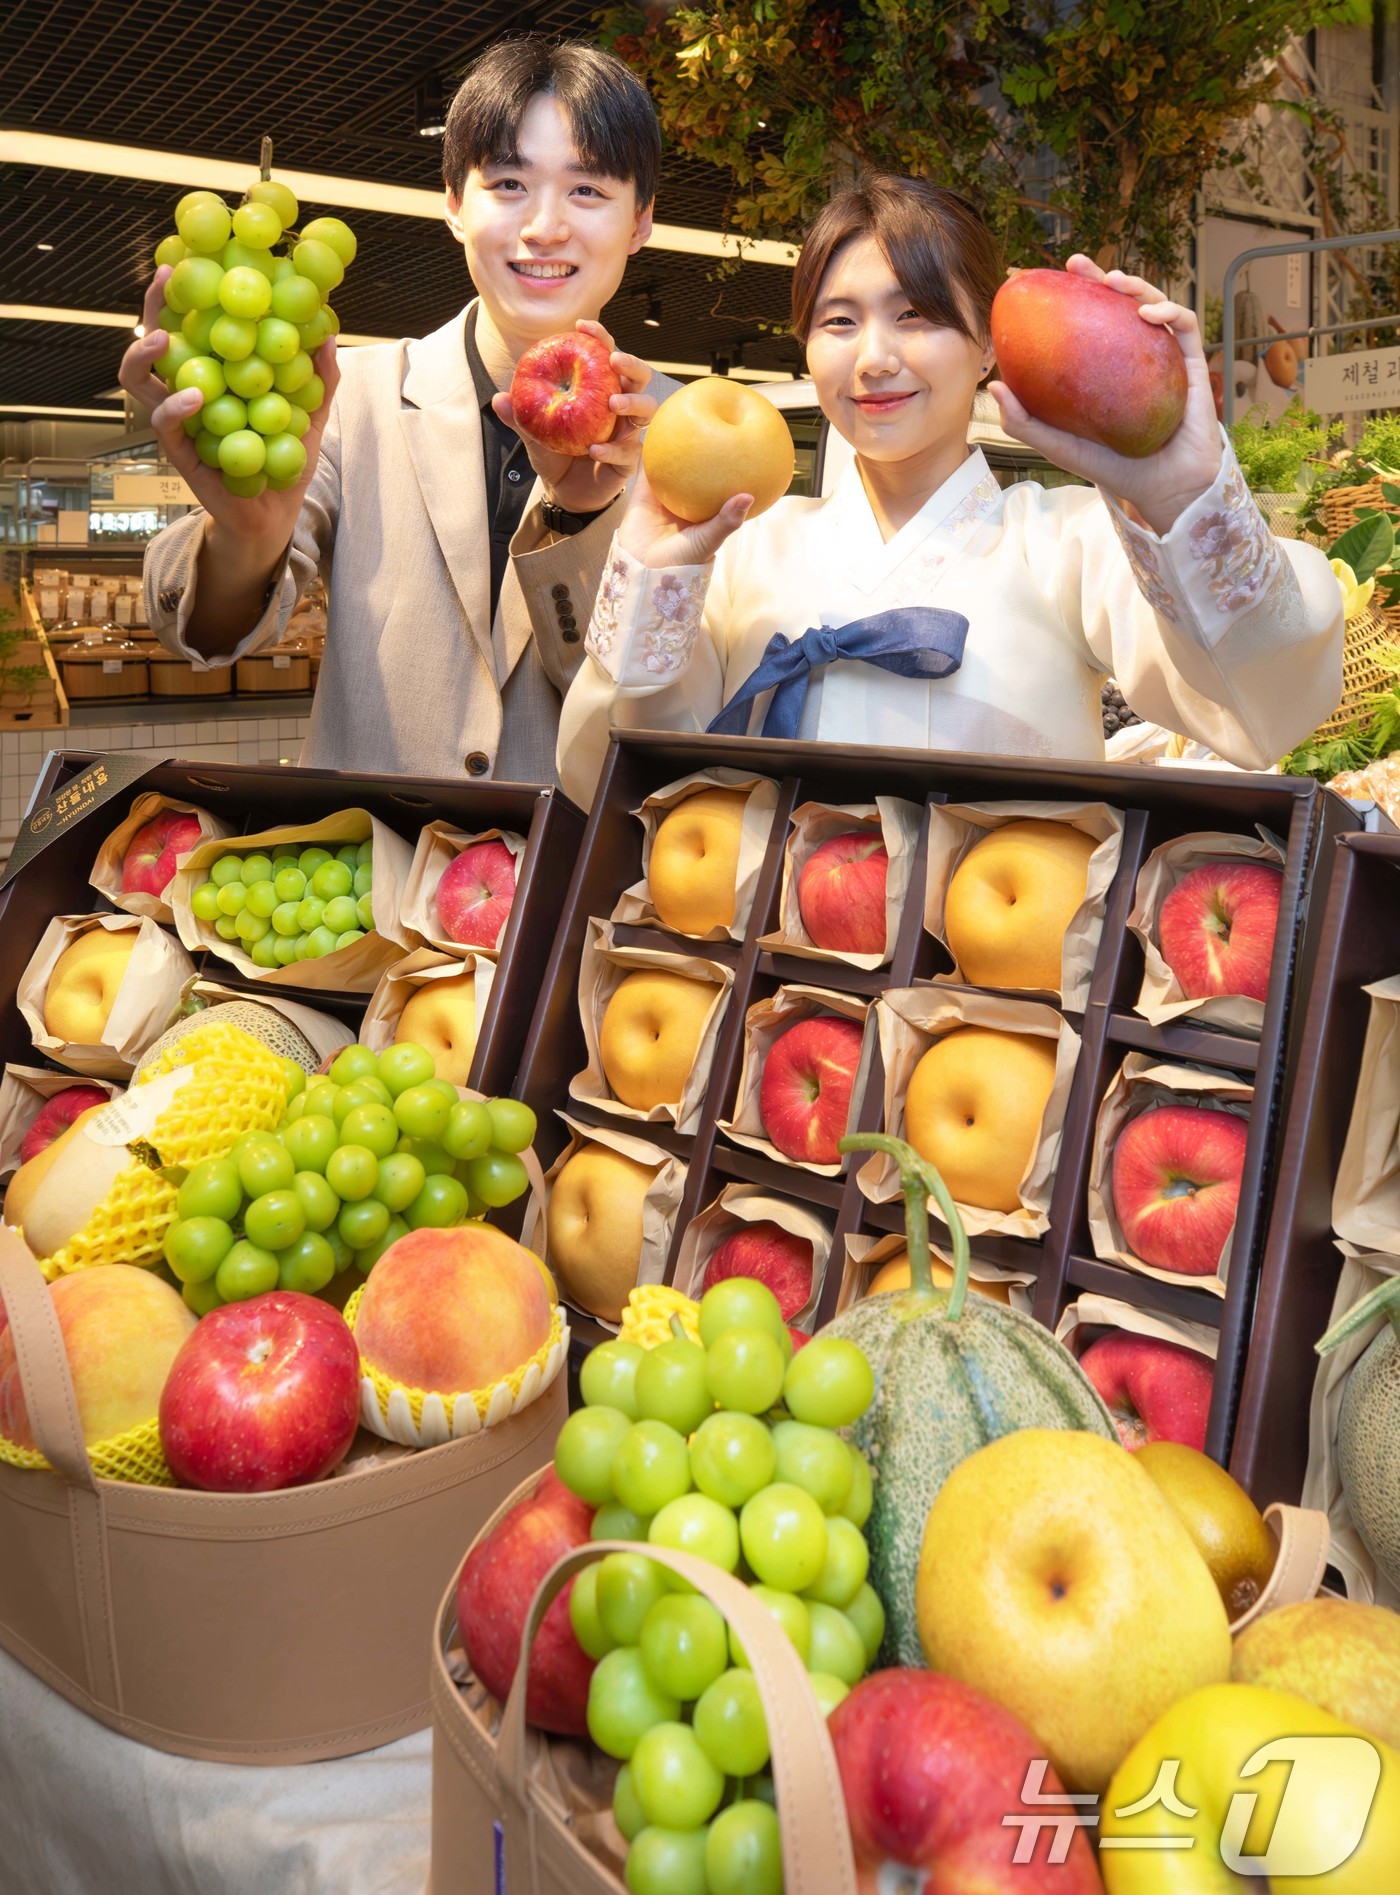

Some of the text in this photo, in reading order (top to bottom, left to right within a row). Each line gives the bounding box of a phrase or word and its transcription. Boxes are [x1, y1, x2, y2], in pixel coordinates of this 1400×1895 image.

[1342, 360, 1378, 386] 제철
[160, 481, 181, 493] 견과
[62, 797, 95, 823] HYUNDAI
